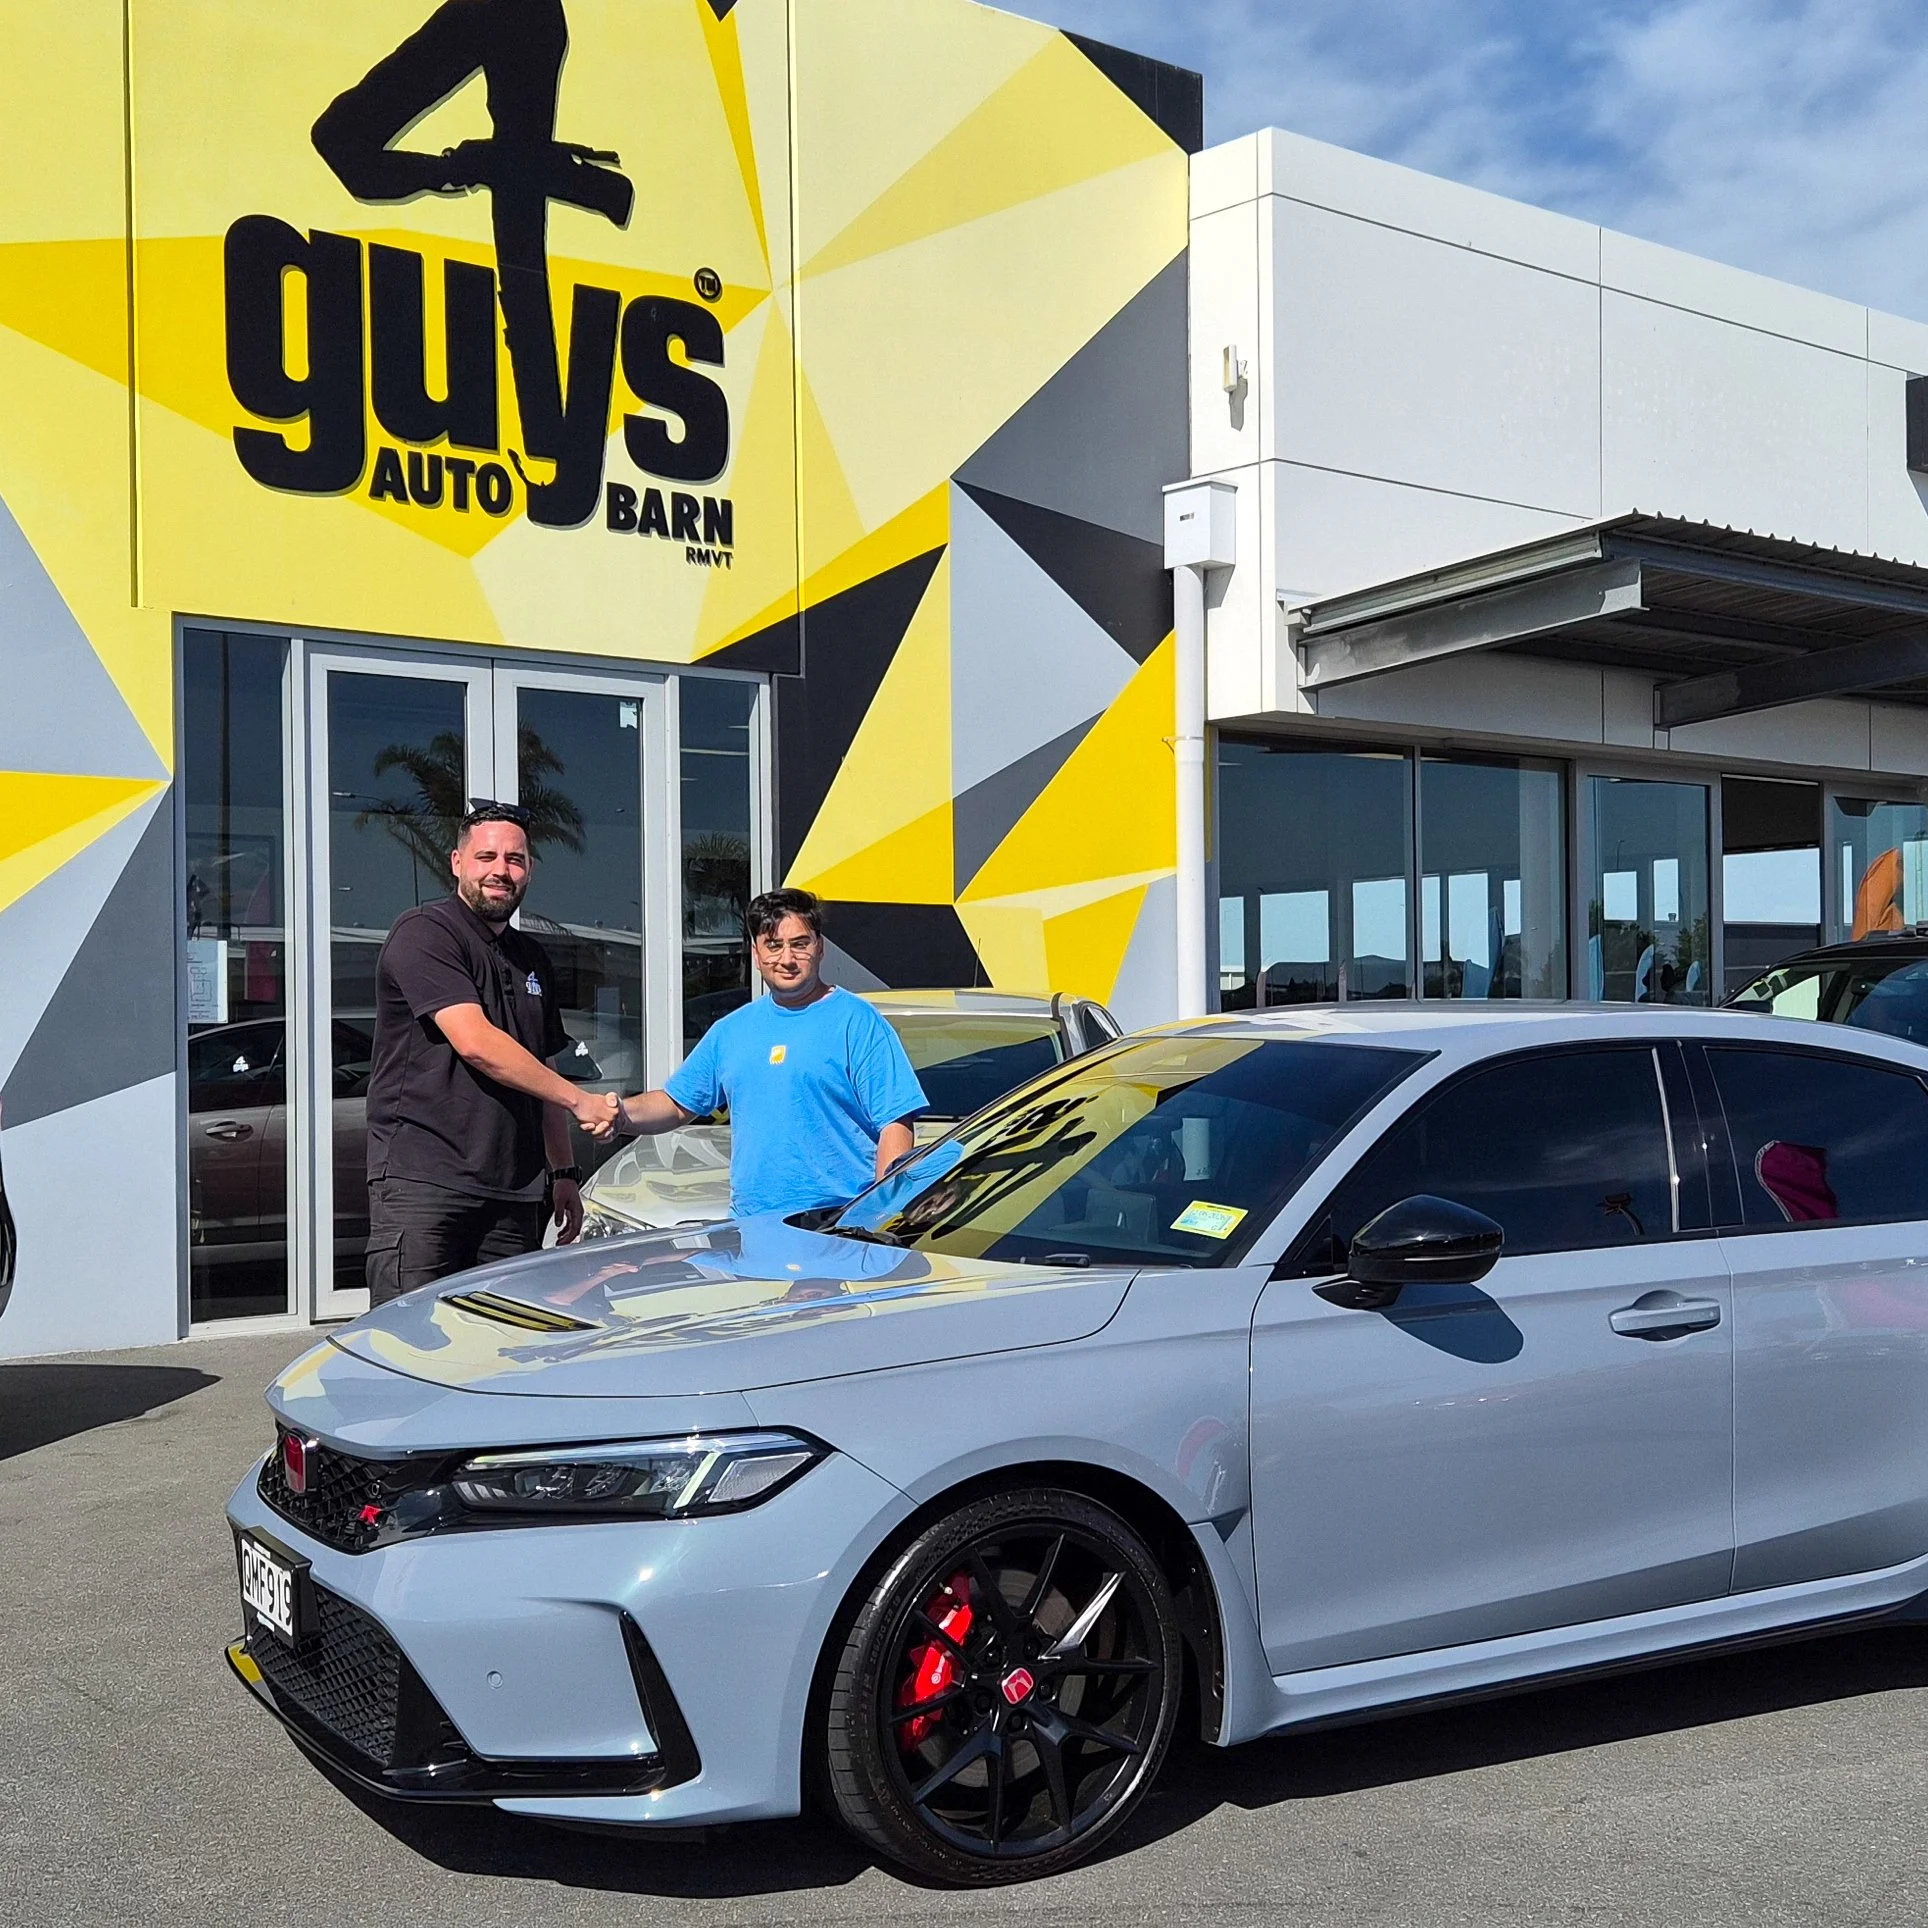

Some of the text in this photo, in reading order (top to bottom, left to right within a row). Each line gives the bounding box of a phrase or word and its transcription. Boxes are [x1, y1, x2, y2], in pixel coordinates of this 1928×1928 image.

[311, 0, 634, 285] 4
[224, 214, 728, 530] guys
[369, 447, 734, 548] AUTO BARN
[686, 547, 733, 569] RMVT
[243, 1548, 293, 1627] QMF919
